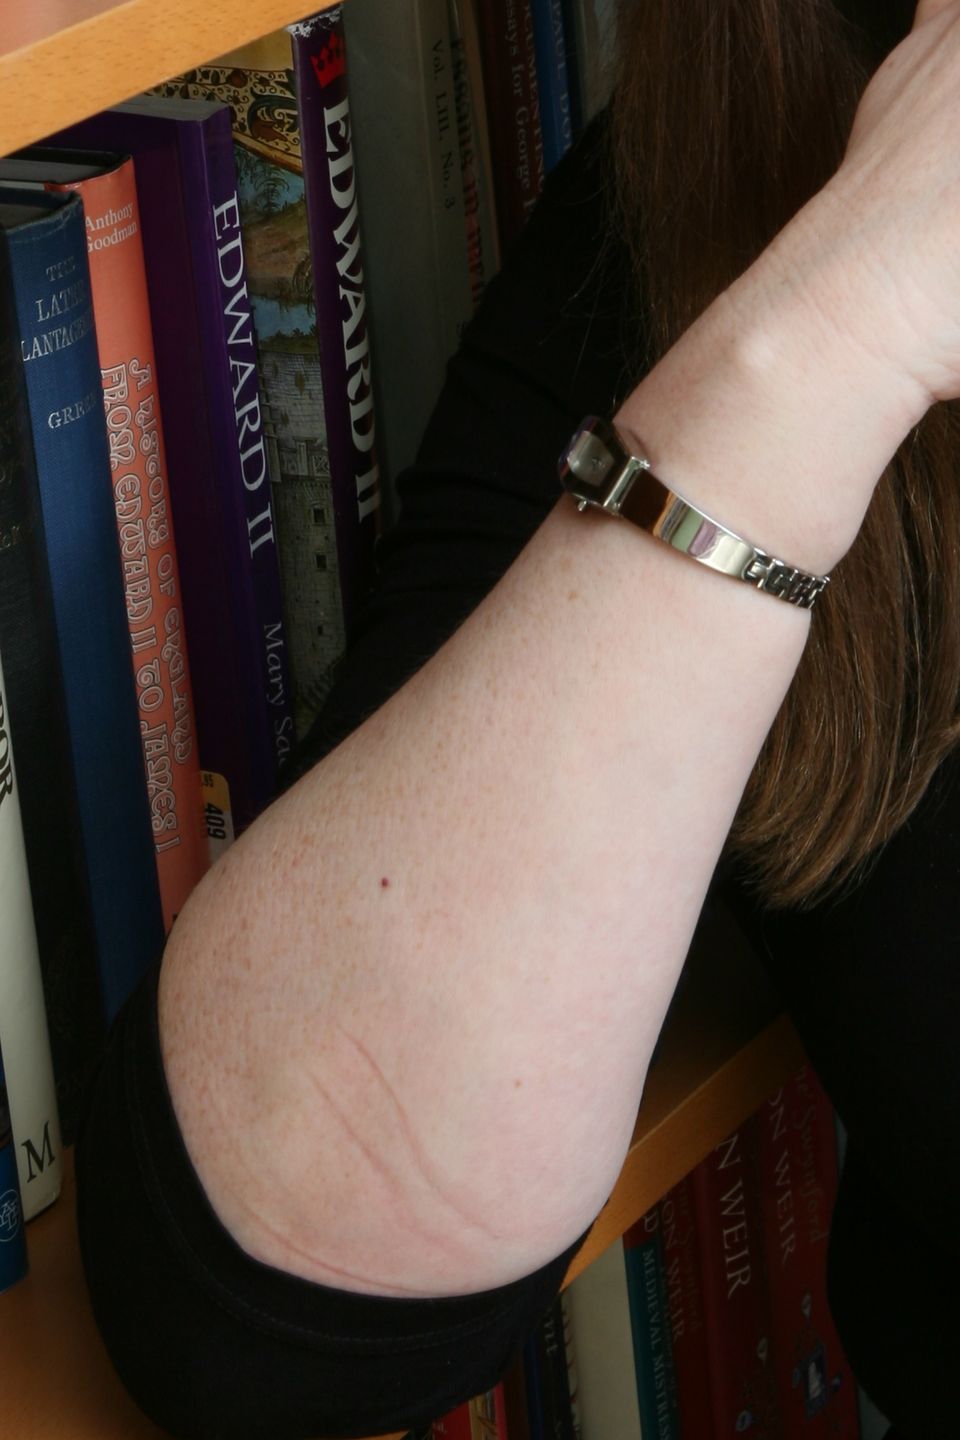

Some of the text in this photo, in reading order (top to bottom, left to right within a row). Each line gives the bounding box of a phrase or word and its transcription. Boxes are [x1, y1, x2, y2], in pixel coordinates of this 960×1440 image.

[431, 39, 445, 82] Vol.
[511, 63, 525, 98] for
[441, 151, 455, 189] No.
[514, 105, 531, 191] George
[85, 201, 134, 233] Anthony
[444, 198, 456, 210] 3
[46, 256, 76, 283] THE
[323, 99, 382, 523] EDWARD II
[100, 362, 137, 470] FROM
[212, 190, 275, 559] EDWARD II
[114, 474, 153, 625] EDWARD
[127, 357, 193, 765] A HISTORY OF ENGLAND
[130, 624, 158, 654] II
[263, 621, 285, 708] Mary
[136, 658, 165, 712] TO
[141, 720, 179, 835] JAMES
[21, 1122, 55, 1183] M
[718, 1177, 752, 1301] WEIR
[773, 1148, 797, 1272] WEIR
[642, 1246, 666, 1352] MEDIEVAL
[665, 1257, 687, 1345] WEIR
